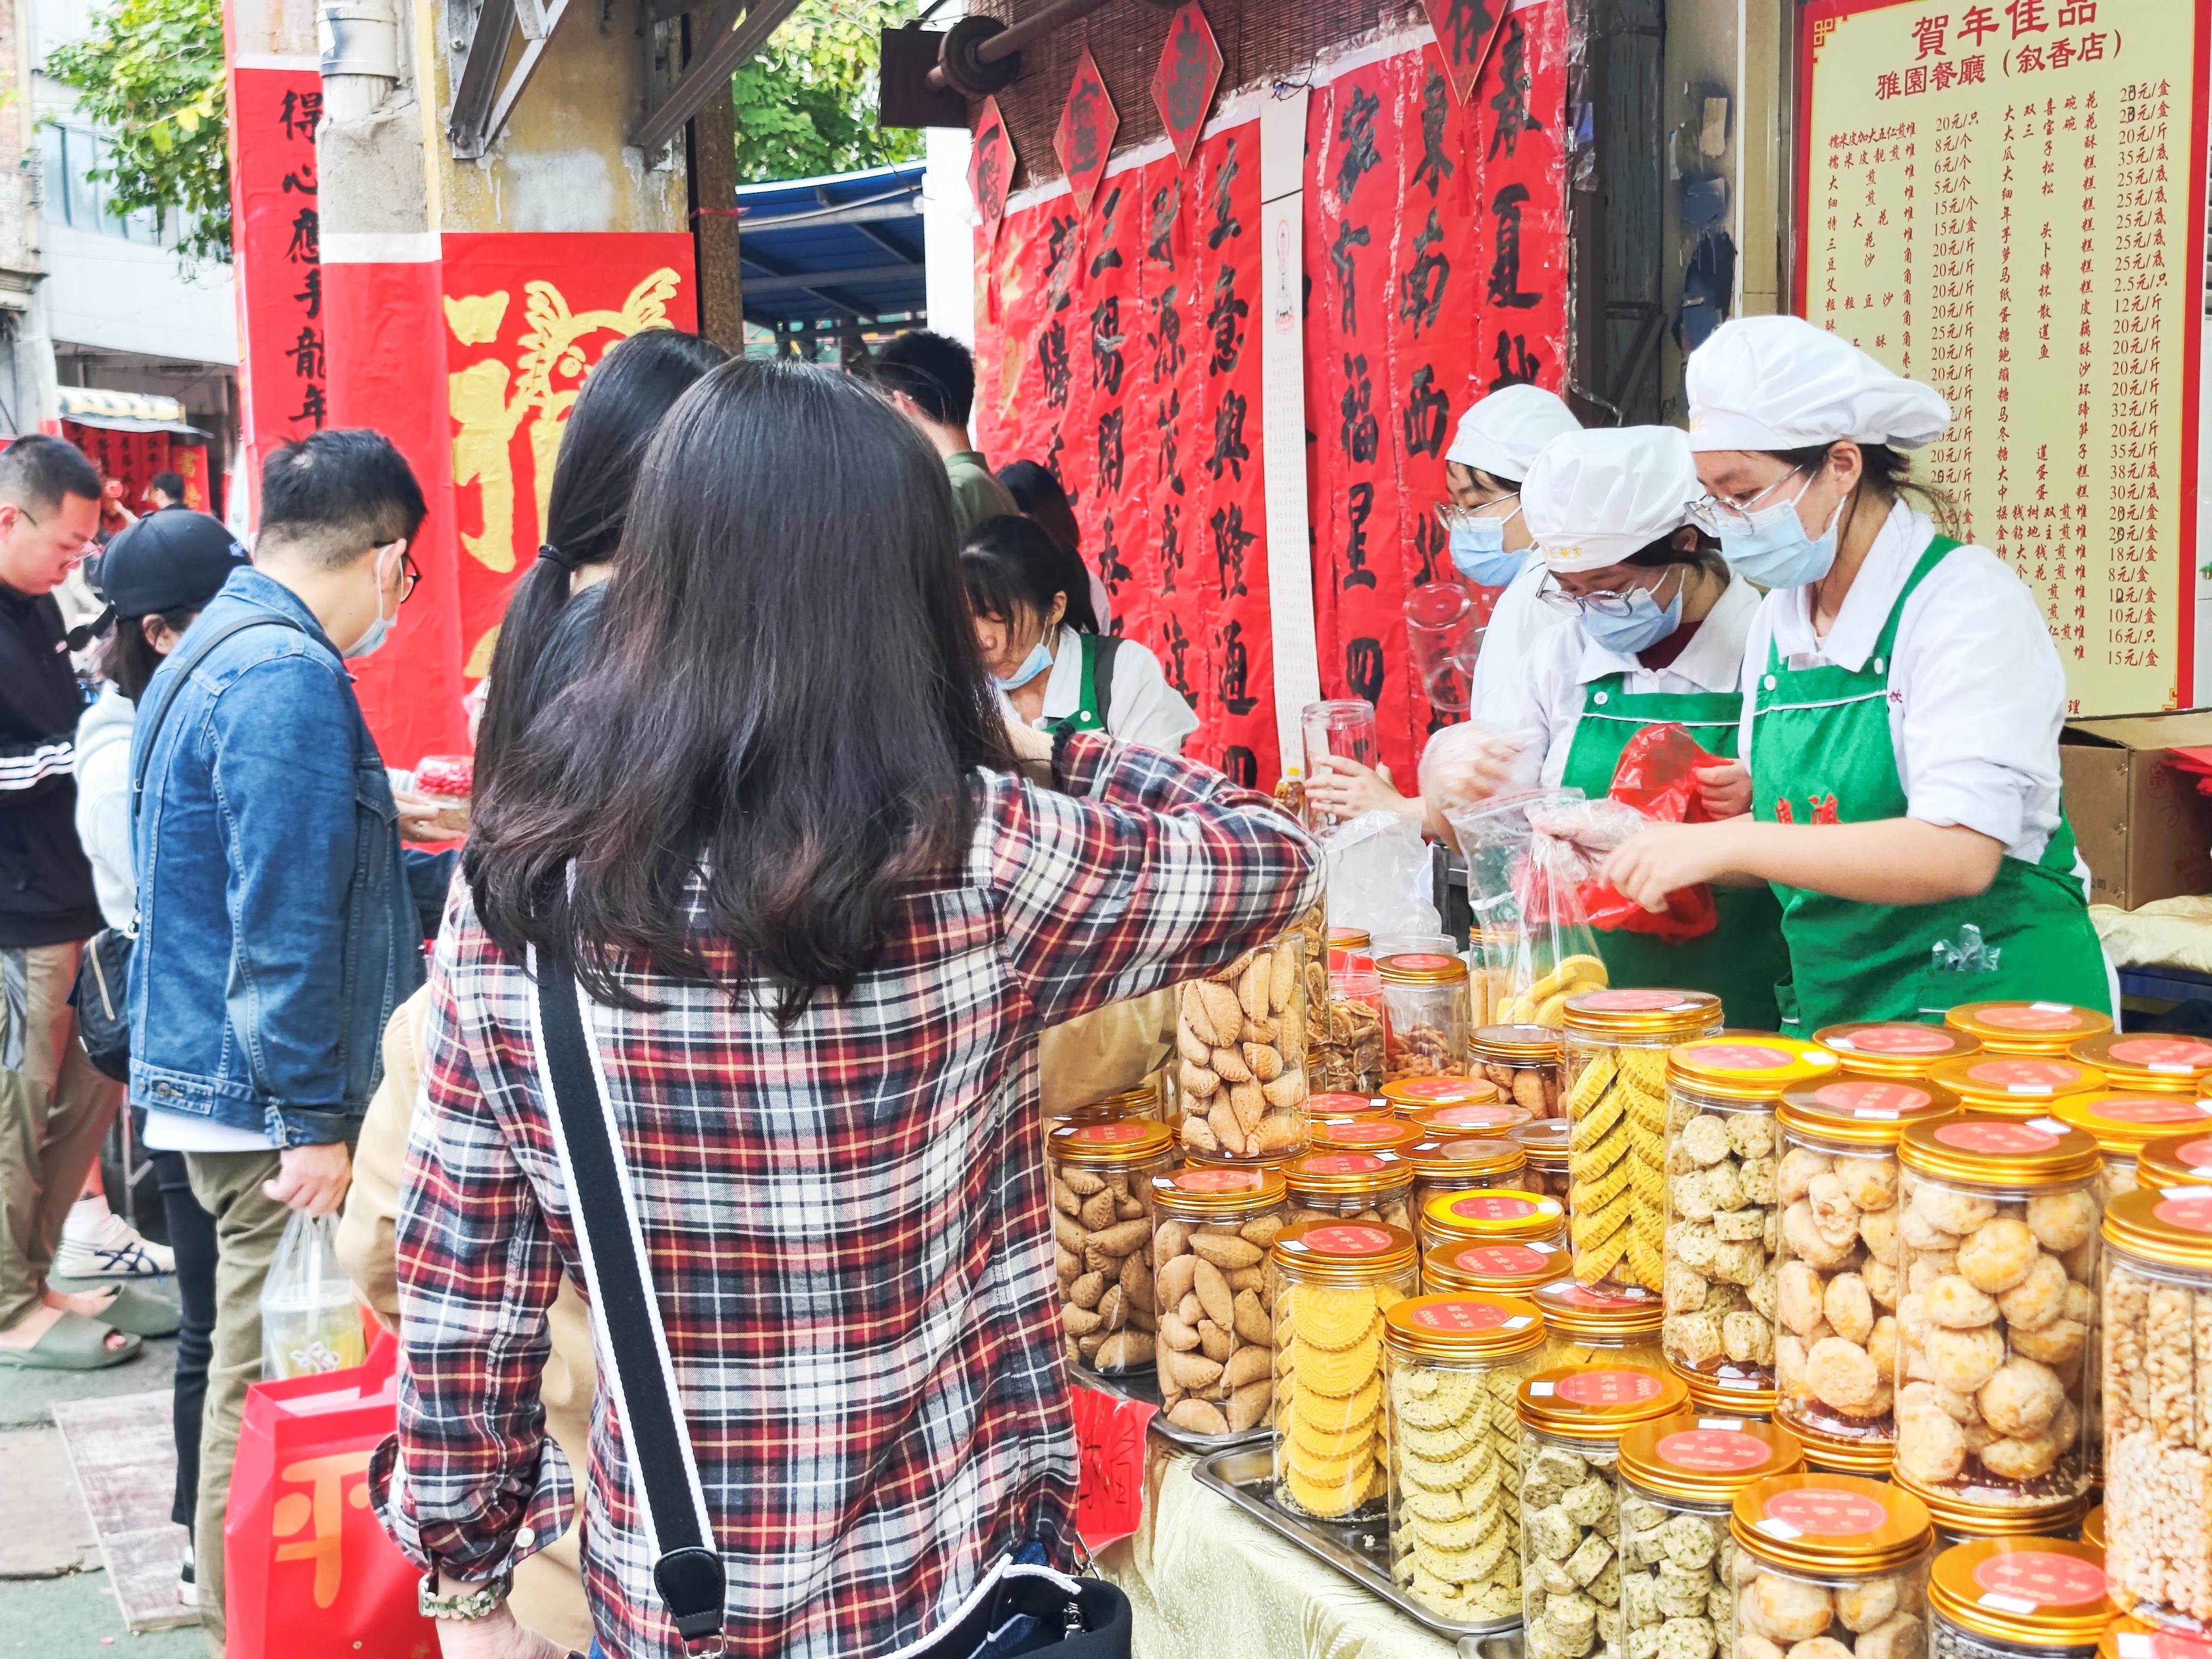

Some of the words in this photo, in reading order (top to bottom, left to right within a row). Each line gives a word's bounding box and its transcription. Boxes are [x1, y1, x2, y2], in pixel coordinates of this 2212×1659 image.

[1936, 111, 1979, 131] 20元/只
[1935, 133, 1972, 153] 8元/个
[2002, 134, 2098, 163] 瓜子酥
[2119, 122, 2168, 145] 20元/斤
[1828, 164, 1914, 190] 大煎堆
[1934, 154, 1972, 173] 6元/个
[2001, 154, 2096, 182] 大松糕
[2117, 143, 2169, 167] 35元/底
[2001, 176, 2096, 201] 细松糕
[2117, 164, 2168, 187] 25元/底
[1827, 185, 1914, 210] 细煎堆
[1934, 176, 1971, 194] 5元/个
[1827, 206, 1913, 231] 特大花堆
[1934, 195, 1979, 215] 15元/个
[2000, 196, 2095, 224] 年糕
[2116, 185, 2167, 208] 25元/底
[1826, 227, 1913, 251] 三花堆
[1934, 216, 1977, 236] 15元/盒
[2000, 217, 2095, 244] 芋头糕
[2116, 206, 2167, 230] 25元/底
[1826, 247, 1912, 272] 豆沙角
[1932, 238, 1975, 257] 20元/斤
[2001, 238, 2094, 265] 萝卜糕
[2115, 228, 2166, 251] 25元/底
[1826, 268, 1911, 292] 艾角
[1932, 259, 1975, 278] 20元/斤
[1999, 259, 2094, 284] 马蹄糕
[2115, 249, 2166, 272] 25元/底
[1825, 289, 1911, 312] 粒粒豆沙角
[1932, 280, 1974, 299] 20元/斤
[1999, 279, 2093, 302] 纸杯糕
[2114, 272, 2168, 293] 2.5元/只
[1825, 309, 1911, 332] 酥角
[1932, 301, 1974, 319] 20元/斤
[1999, 299, 2092, 323] 蛋散皮
[2114, 293, 2162, 313] 12元/斤
[1931, 321, 1974, 340] 25元/斤
[2113, 314, 2161, 334] 20元/斤
[1931, 342, 1973, 361] 20元/斤
[2112, 335, 2161, 355] 20元/斤
[1931, 363, 1973, 381] 20元/斤
[2112, 356, 2160, 376] 20元/斤
[1937, 384, 1973, 402] 0元/斤
[2112, 377, 2160, 396] 20元/斤
[1089, 187, 1133, 636] 三陽開泰
[1997, 401, 2090, 423] 马蹄
[2111, 399, 2159, 417] 32元/斤
[2111, 420, 2159, 438] 20元/斤
[1930, 447, 1973, 463] 20元/斤
[2110, 441, 2158, 459] 35元/斤
[1997, 463, 2089, 481] 大蛋糕
[2109, 461, 2160, 480] 38元/底
[1997, 483, 2089, 502] 中蛋糕
[2109, 482, 2159, 500] 30元/底
[1995, 523, 2087, 541] 金钻地主煎堆
[1997, 543, 2087, 561] 特大钱煎堆
[2109, 544, 2159, 562] 18元/盒
[2108, 565, 2150, 583] 8元/盒
[2109, 606, 2157, 624] 10元/盒
[2108, 627, 2156, 644] 16元/只
[2108, 648, 2160, 667] 15元/盒
[2068, 699, 2081, 714] 理
